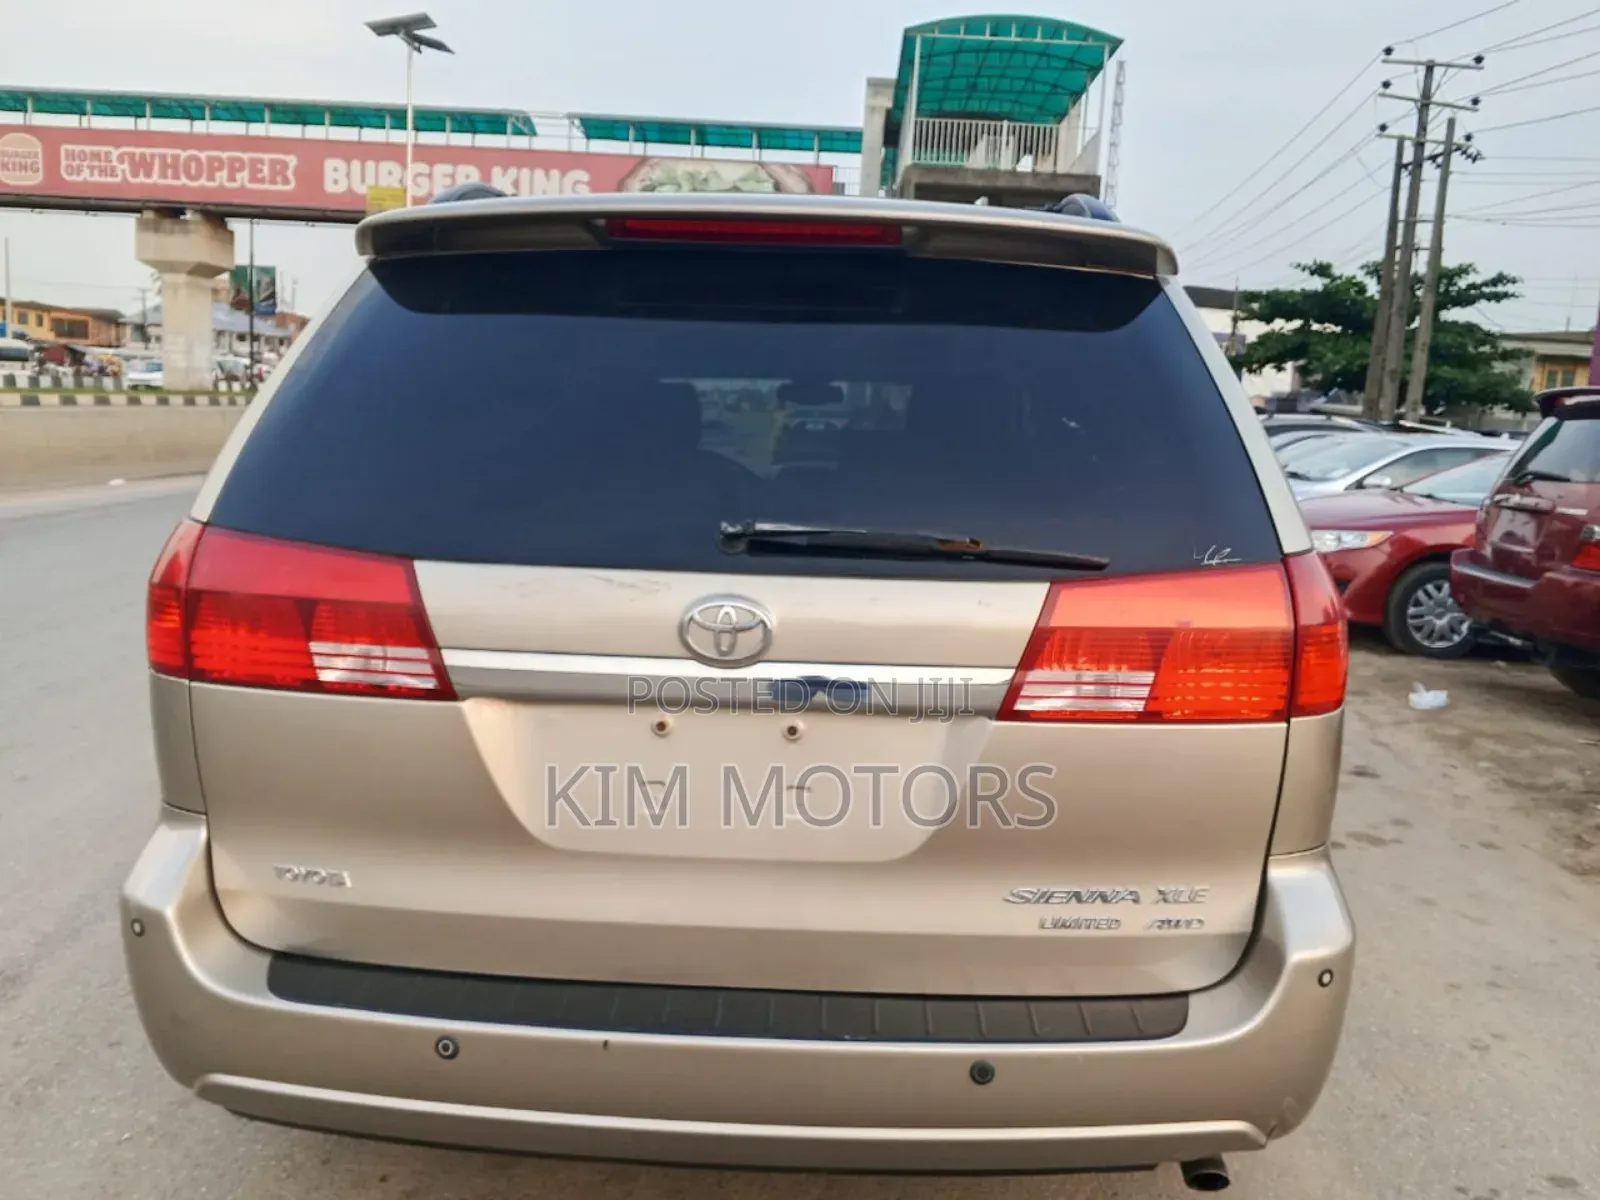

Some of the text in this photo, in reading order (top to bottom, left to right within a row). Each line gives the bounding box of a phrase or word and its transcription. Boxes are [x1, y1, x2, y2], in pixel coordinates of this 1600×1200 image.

[63, 148, 113, 163] HOME
[0, 160, 41, 174] KING
[64, 164, 119, 178] OF THE
[116, 151, 292, 186] WHOPPER
[491, 165, 591, 196] KING
[1003, 886, 1210, 905] SIENNA XLE
[1037, 916, 1206, 930] LIMITED AWD
